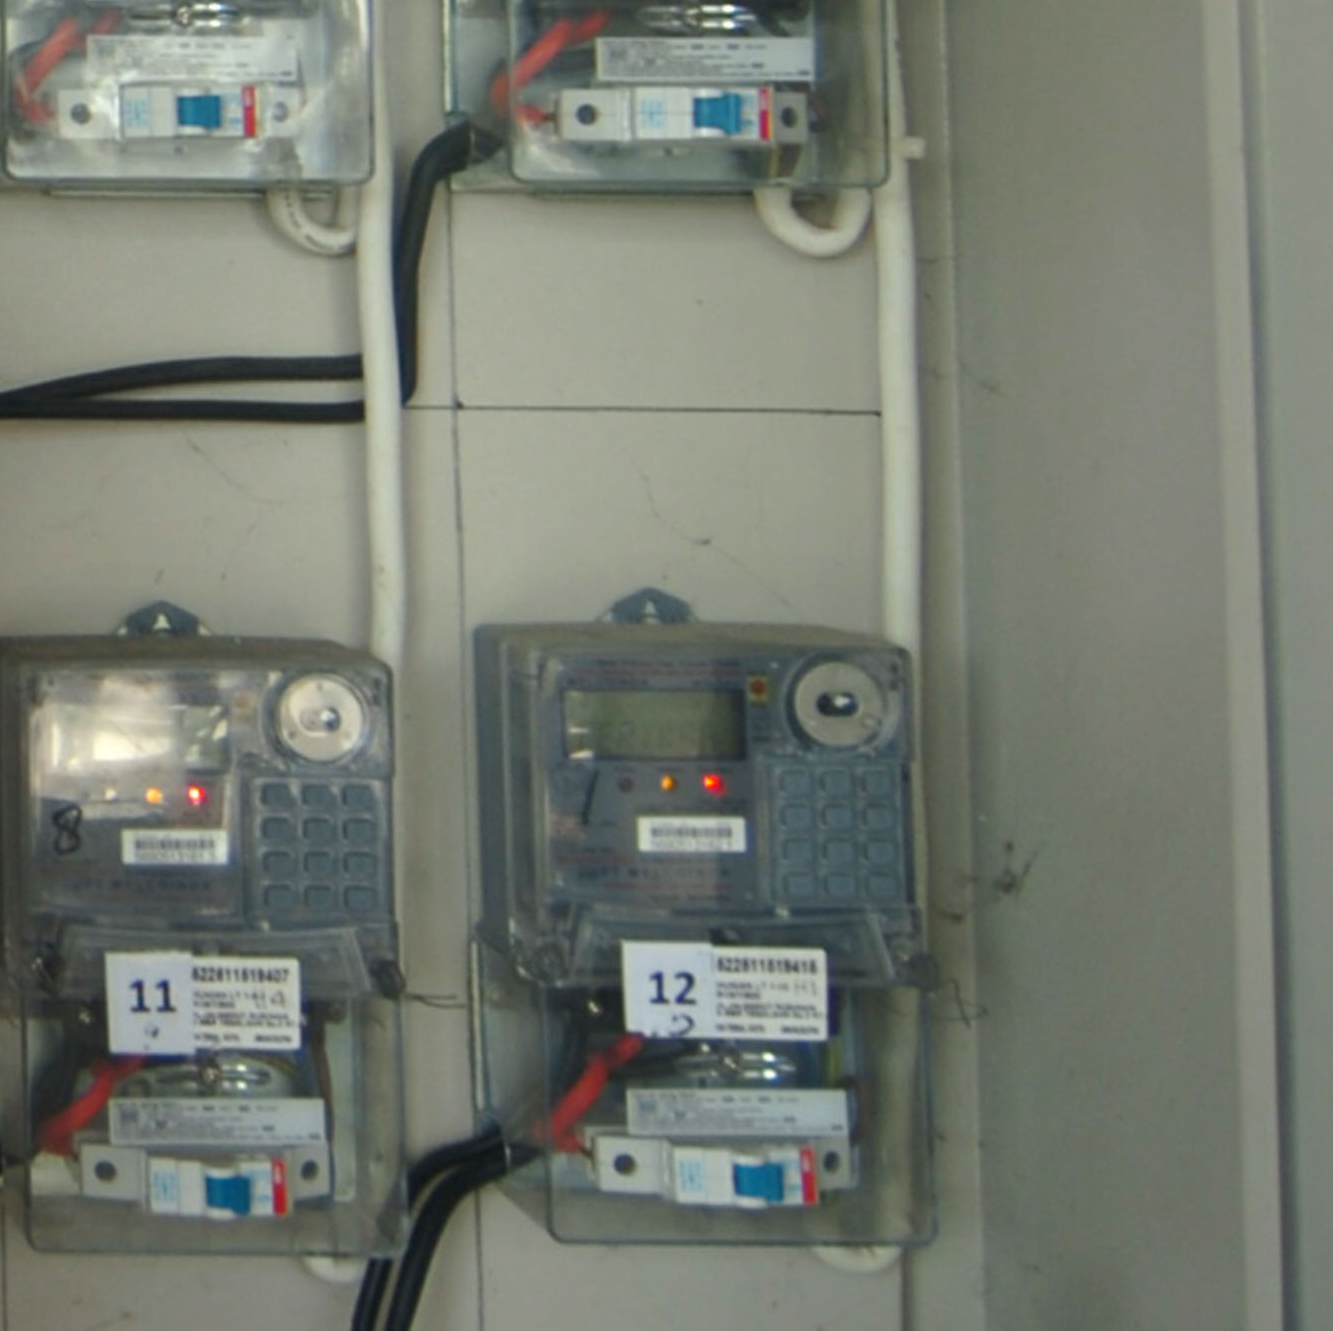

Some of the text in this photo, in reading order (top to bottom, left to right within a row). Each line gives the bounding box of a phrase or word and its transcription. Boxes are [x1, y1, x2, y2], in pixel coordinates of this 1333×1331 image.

[52, 804, 84, 856] 8
[128, 978, 178, 1014] 11
[648, 971, 698, 1007] 12
